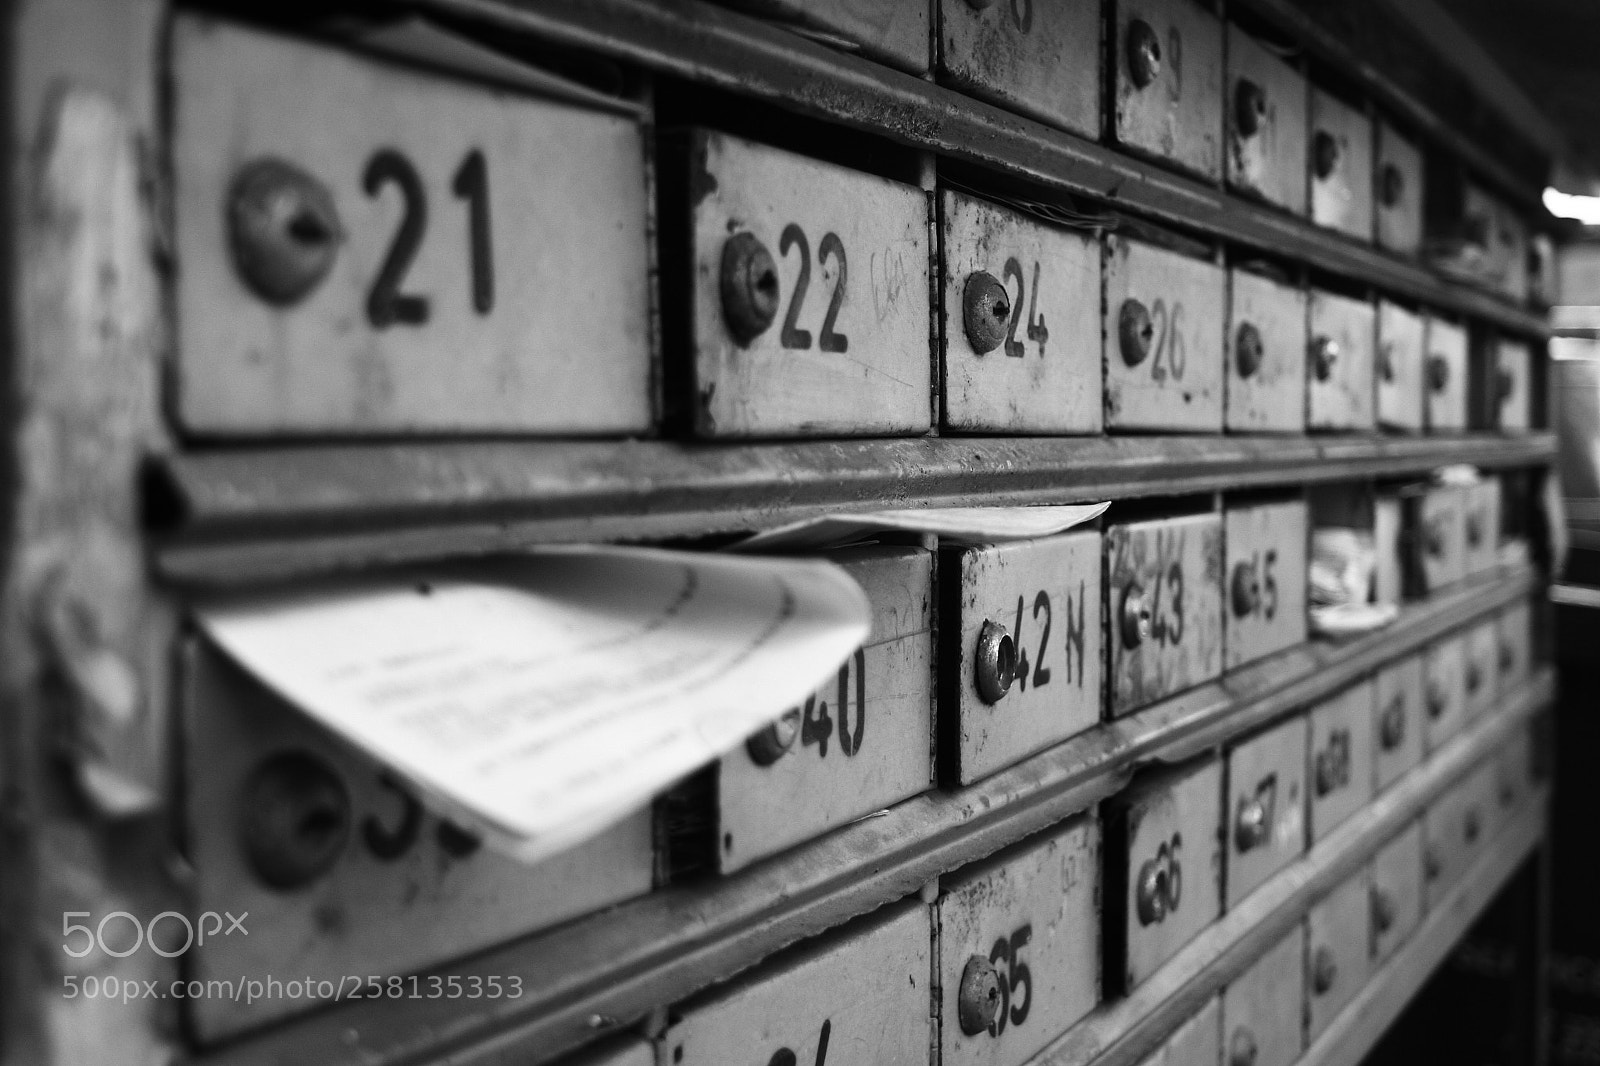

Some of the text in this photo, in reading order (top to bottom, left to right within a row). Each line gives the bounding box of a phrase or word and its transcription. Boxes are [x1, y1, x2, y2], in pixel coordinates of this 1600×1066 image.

[362, 146, 495, 331] 21
[779, 222, 848, 354] 22
[1003, 256, 1049, 359] 24
[1151, 299, 1186, 388] 26
[1014, 590, 1051, 692] 42
[1151, 563, 1184, 649] 43
[801, 647, 865, 758] 40
[362, 764, 484, 863] 3
